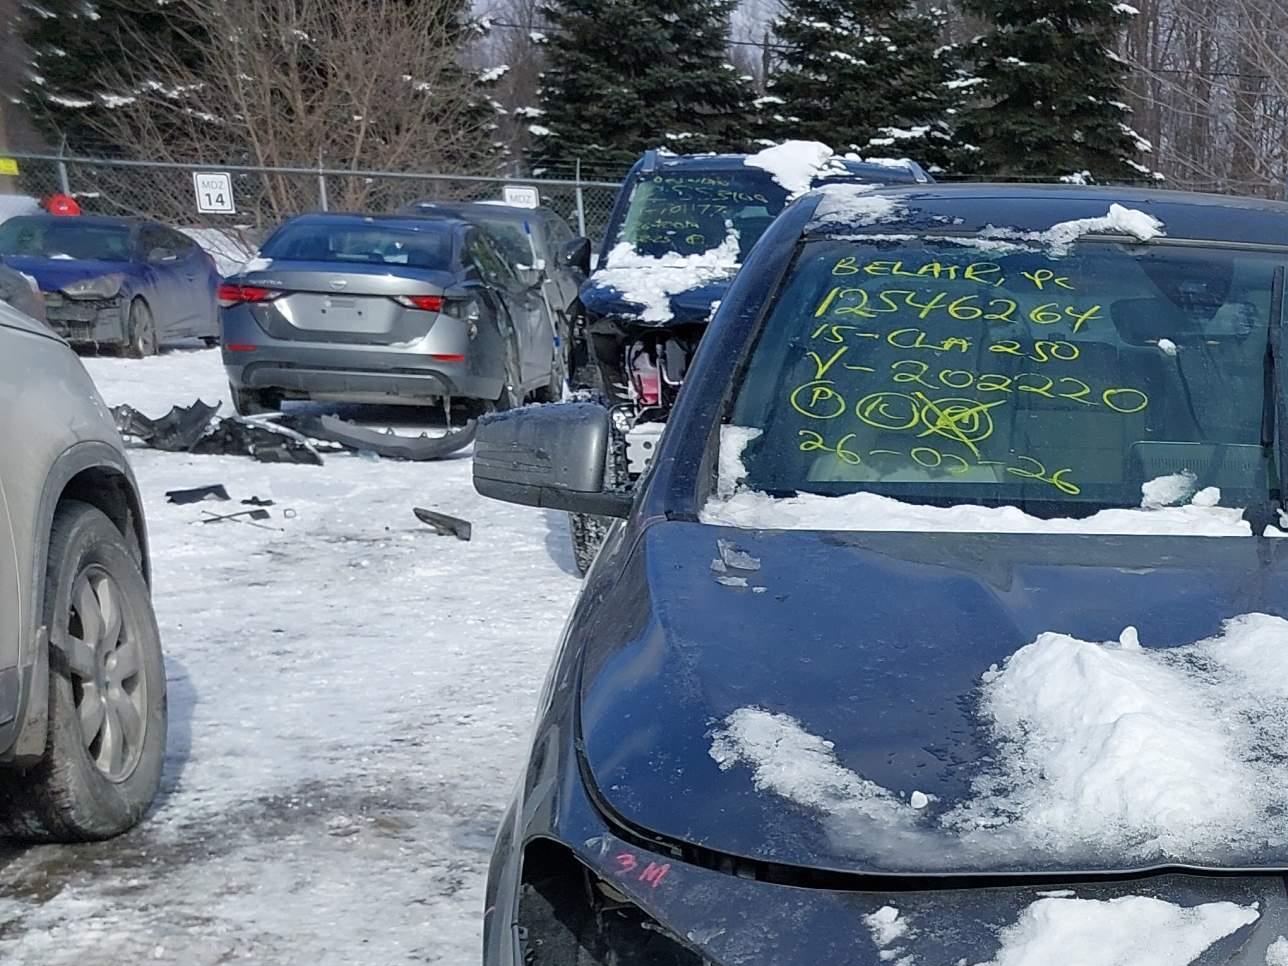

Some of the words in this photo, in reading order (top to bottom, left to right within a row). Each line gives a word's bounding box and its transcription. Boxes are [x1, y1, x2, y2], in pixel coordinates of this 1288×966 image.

[205, 193, 226, 206] 14
[814, 286, 1104, 334] 12546264
[988, 340, 1080, 362] 250
